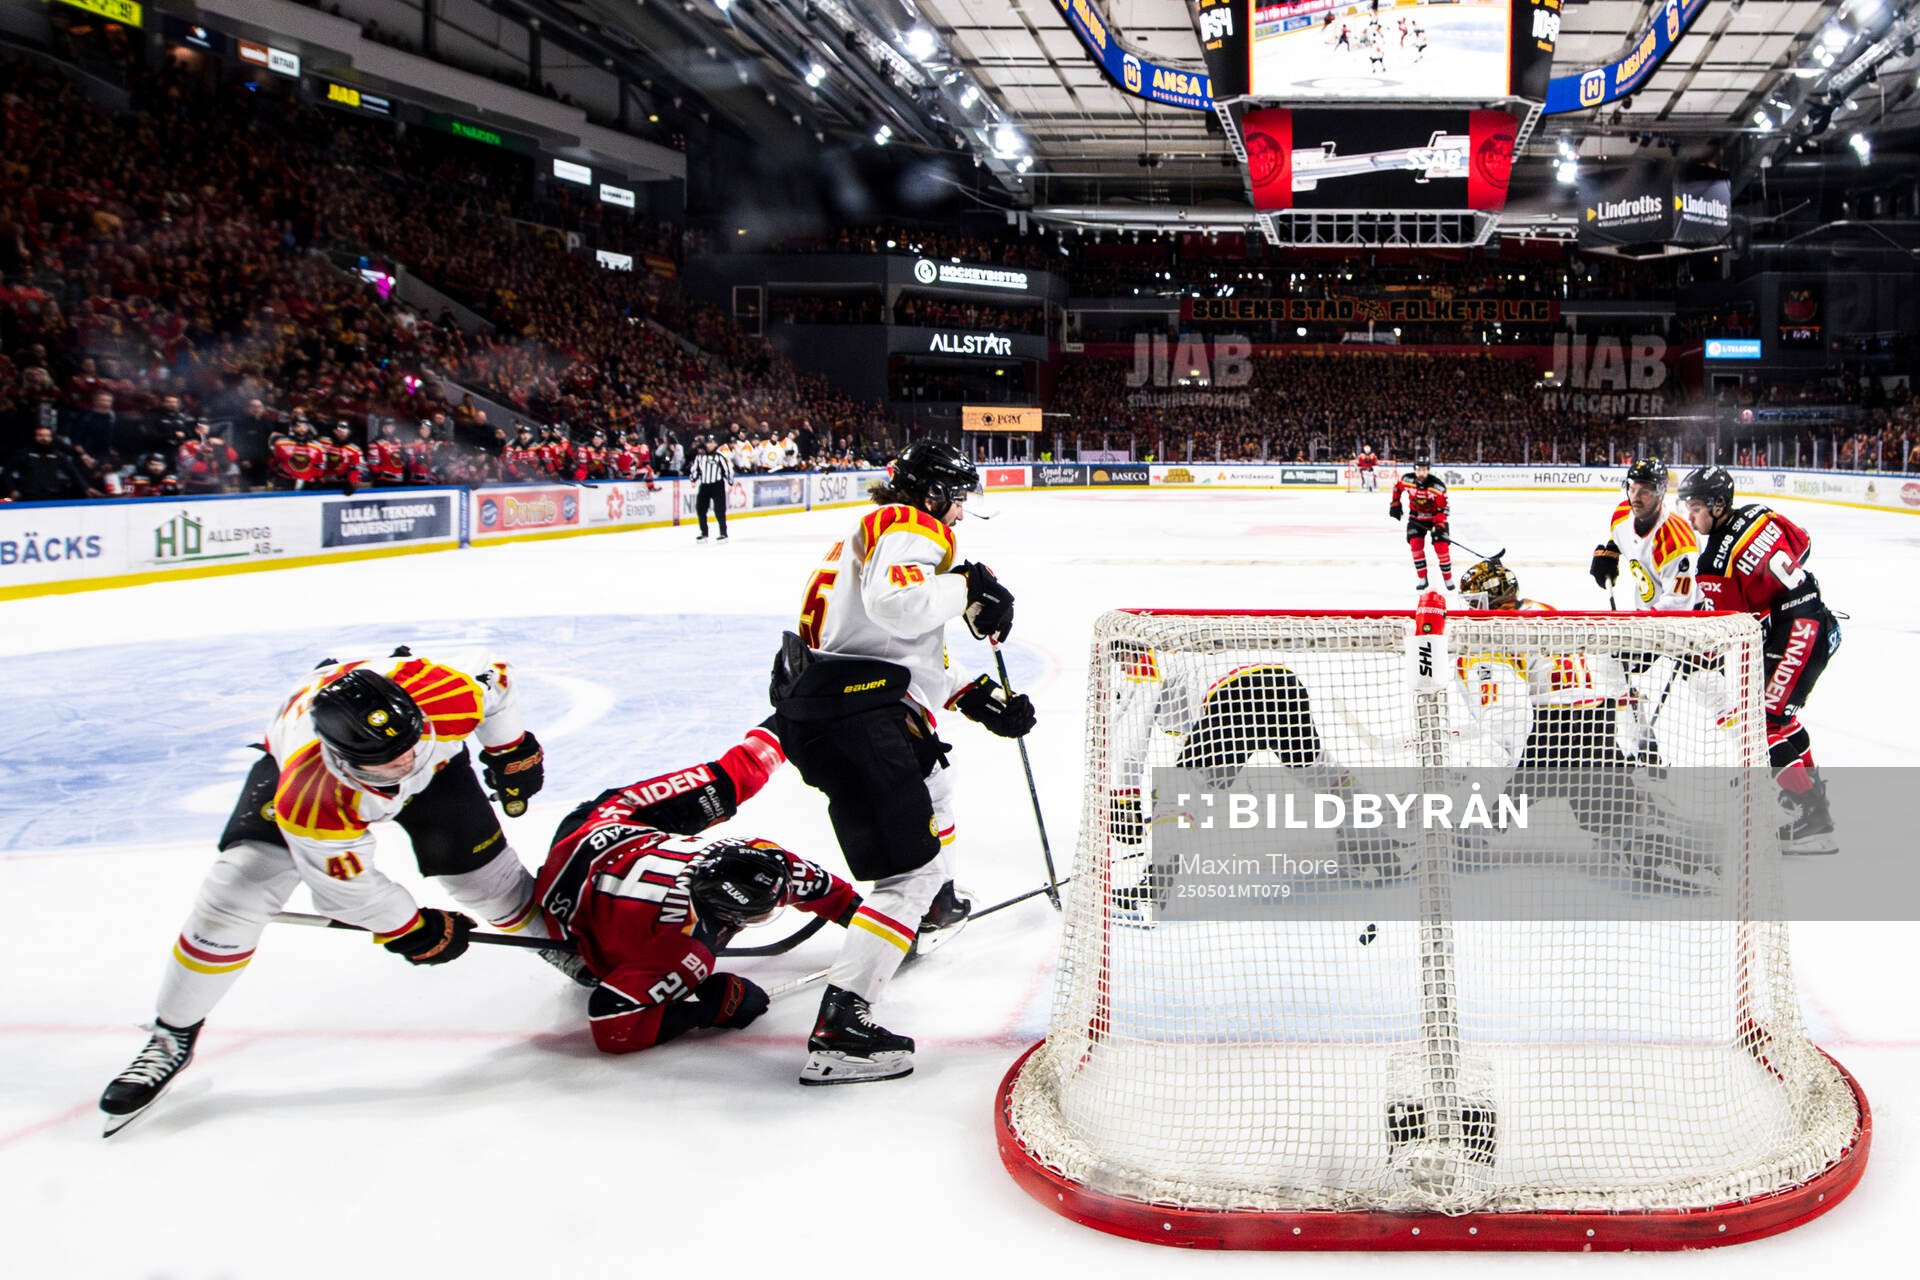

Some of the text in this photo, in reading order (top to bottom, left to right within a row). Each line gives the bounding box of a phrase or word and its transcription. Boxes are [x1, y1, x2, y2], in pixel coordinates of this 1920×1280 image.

[1152, 69, 1202, 96] ANSA
[1406, 150, 1462, 170] SSAB
[1598, 195, 1662, 220] Lindroths
[1682, 193, 1728, 219] Lindroths
[1192, 300, 1286, 320] SOLENS
[1389, 300, 1498, 321] FOLKETS
[1502, 300, 1549, 321] LAG
[930, 332, 1012, 355] ALLSTAR
[1126, 333, 1253, 387] JIAB
[1543, 332, 1667, 389] JIAB
[1112, 472, 1147, 481] BASECO
[819, 476, 848, 502] SSAB
[340, 503, 436, 522] LULEÅ TEKNISKA
[208, 527, 272, 543] ALLBYGG
[340, 519, 416, 537] UNIVERSITET
[0, 532, 102, 565] BÄCKS
[252, 542, 272, 554] AB
[888, 565, 925, 589] 45
[1673, 576, 1691, 595] 70
[1419, 642, 1432, 677] SHL
[844, 679, 886, 693] BAUER
[326, 851, 363, 880] 41
[728, 886, 750, 905] LKAB
